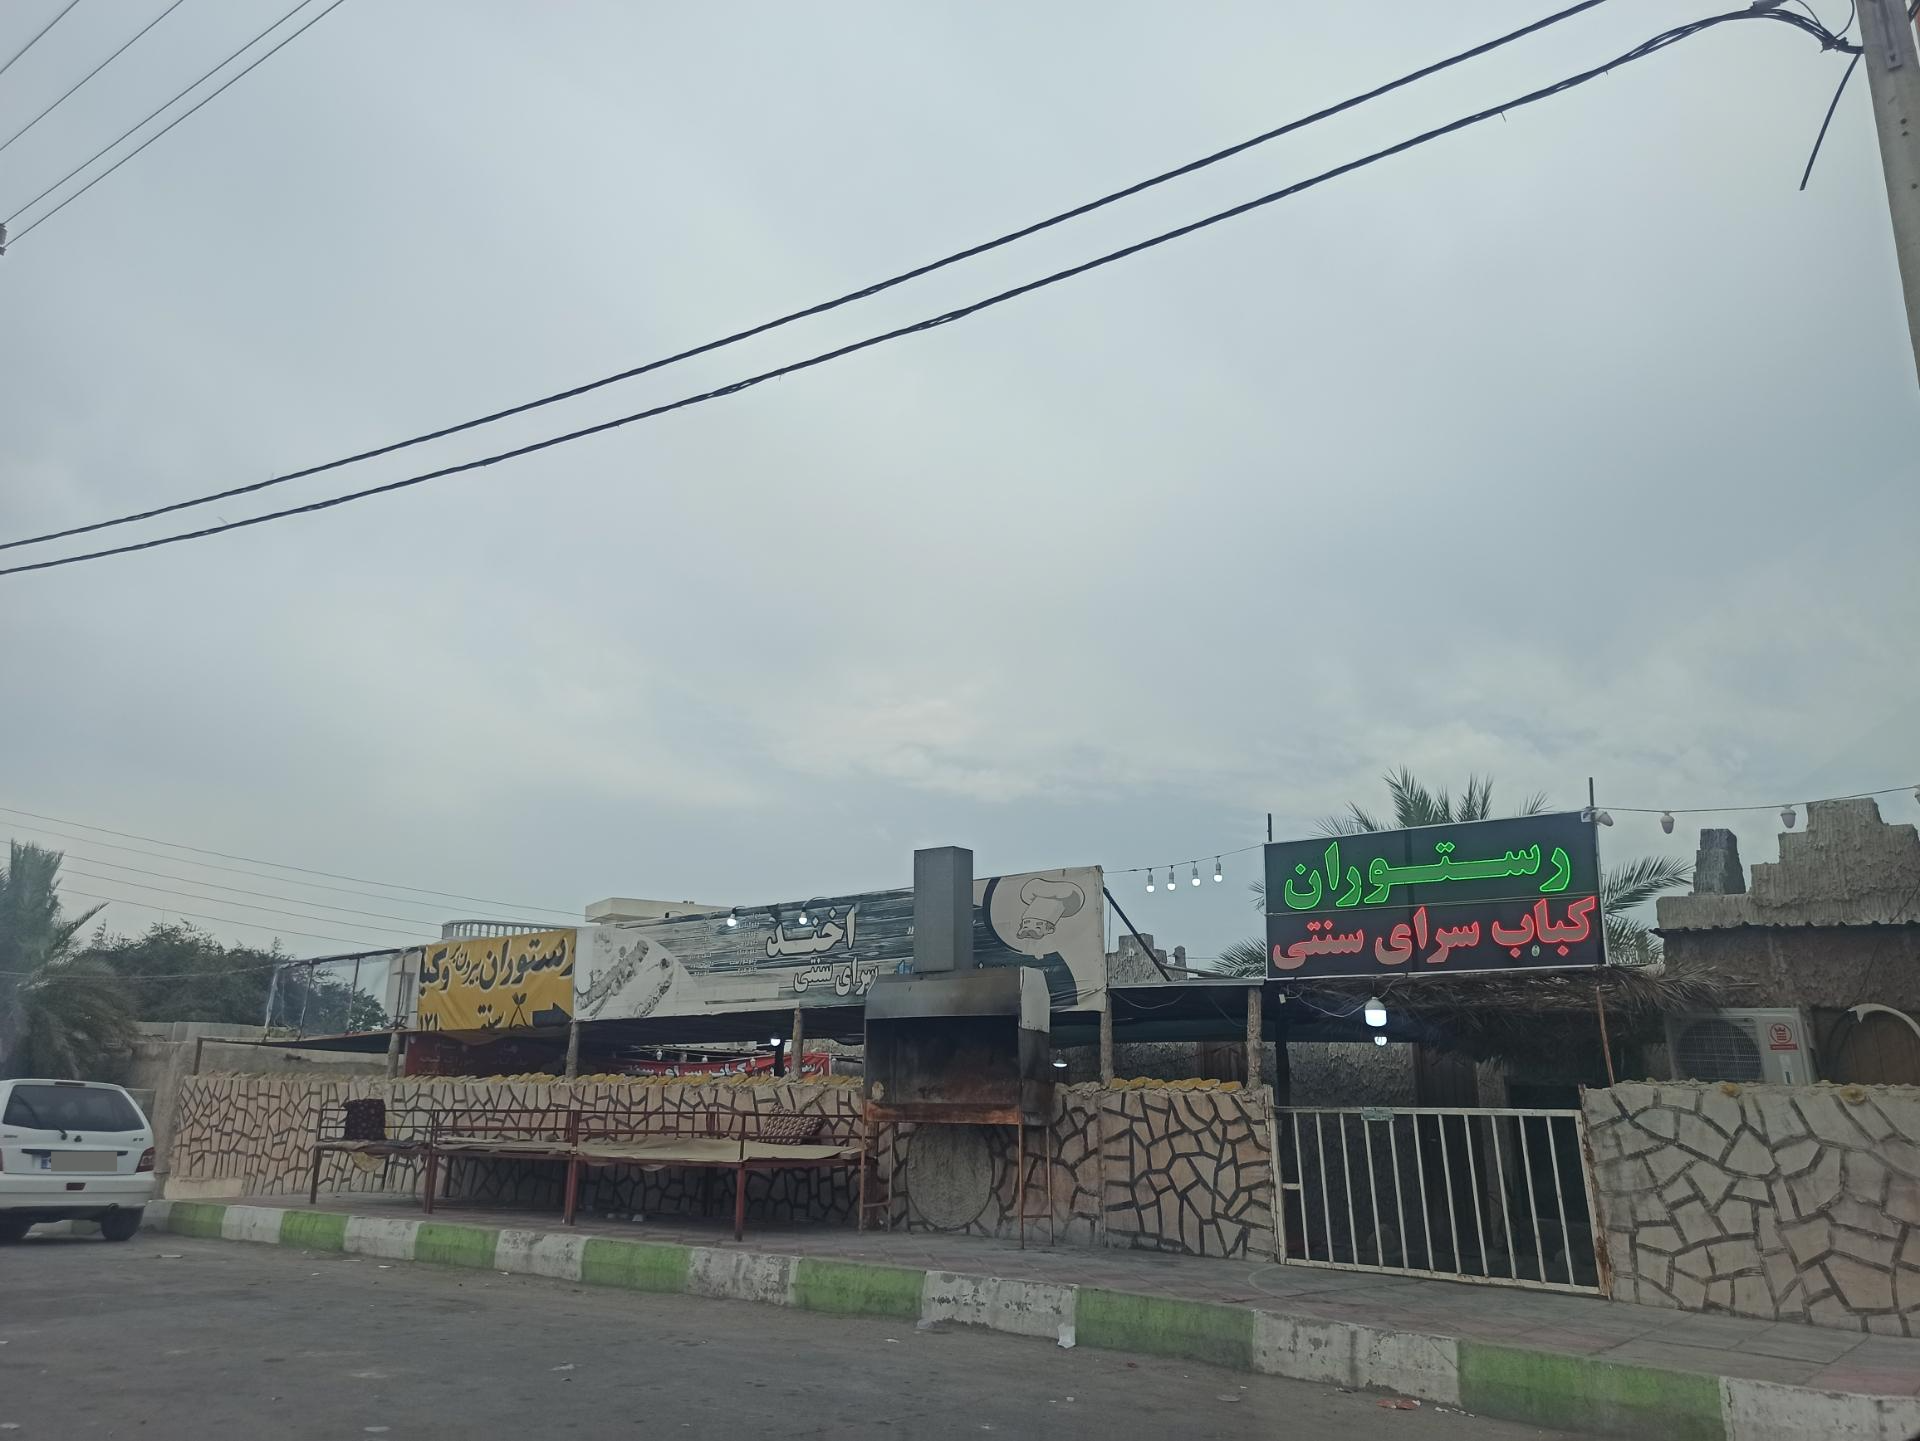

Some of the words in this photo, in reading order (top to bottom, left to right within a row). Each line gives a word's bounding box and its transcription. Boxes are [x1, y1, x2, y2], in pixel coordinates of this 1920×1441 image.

[1283, 841, 1571, 910] رستوران
[766, 904, 857, 958] اخند
[1272, 920, 1364, 970] سنتی
[1374, 906, 1480, 966] سرای
[1491, 896, 1596, 958] کباب
[419, 946, 449, 997] کبا
[793, 956, 834, 993] سنتی
[836, 955, 879, 997] سرای
